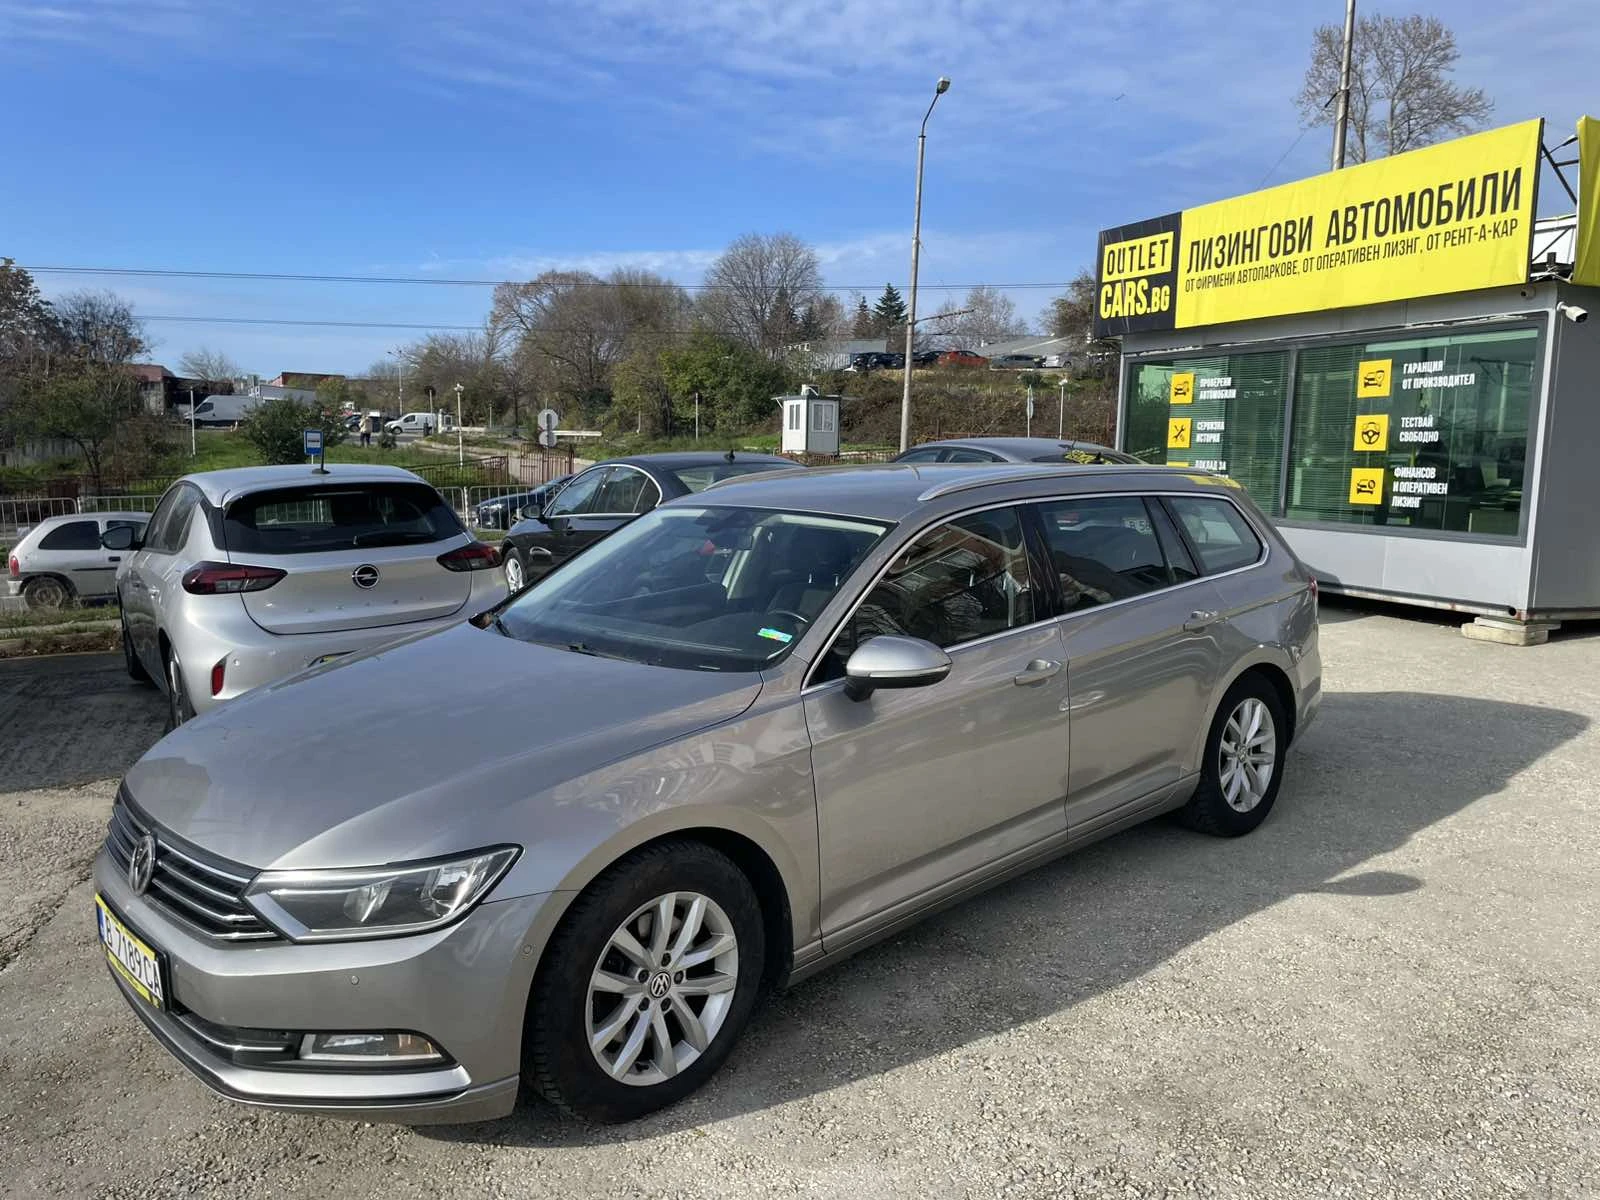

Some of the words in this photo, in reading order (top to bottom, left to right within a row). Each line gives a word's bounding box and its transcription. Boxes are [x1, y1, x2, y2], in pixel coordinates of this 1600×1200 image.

[1186, 215, 1314, 274] ЛИЗИНГОВИ
[1325, 167, 1522, 249] АВТОМОБИЛИ
[1106, 239, 1169, 276] OUTLET
[1185, 278, 1197, 293] ОТ
[1196, 270, 1236, 291] ФИРМЕНИ
[1236, 259, 1301, 284] АВТОПАРКОВЕ,
[1302, 256, 1316, 273] ОТ
[1316, 246, 1380, 271] ОПЕРАТИВЕН
[1426, 232, 1440, 251] ОТ
[1443, 218, 1519, 248] РЕНТ-А-КАР
[1100, 278, 1171, 319] CARS.BG
[1403, 360, 1444, 374] ГАРАНЦИЯ
[1402, 378, 1413, 390] ОТ
[1413, 373, 1475, 389] ПРОИЗВОДИТЕЛ
[1401, 414, 1434, 428] ТЕСТВАЙ
[1399, 430, 1439, 443] СВОБОДНО
[1394, 467, 1437, 479] ФИНАНСОВ
[1392, 481, 1399, 492] И
[1399, 481, 1448, 495] ОПЕРАТИВЕН
